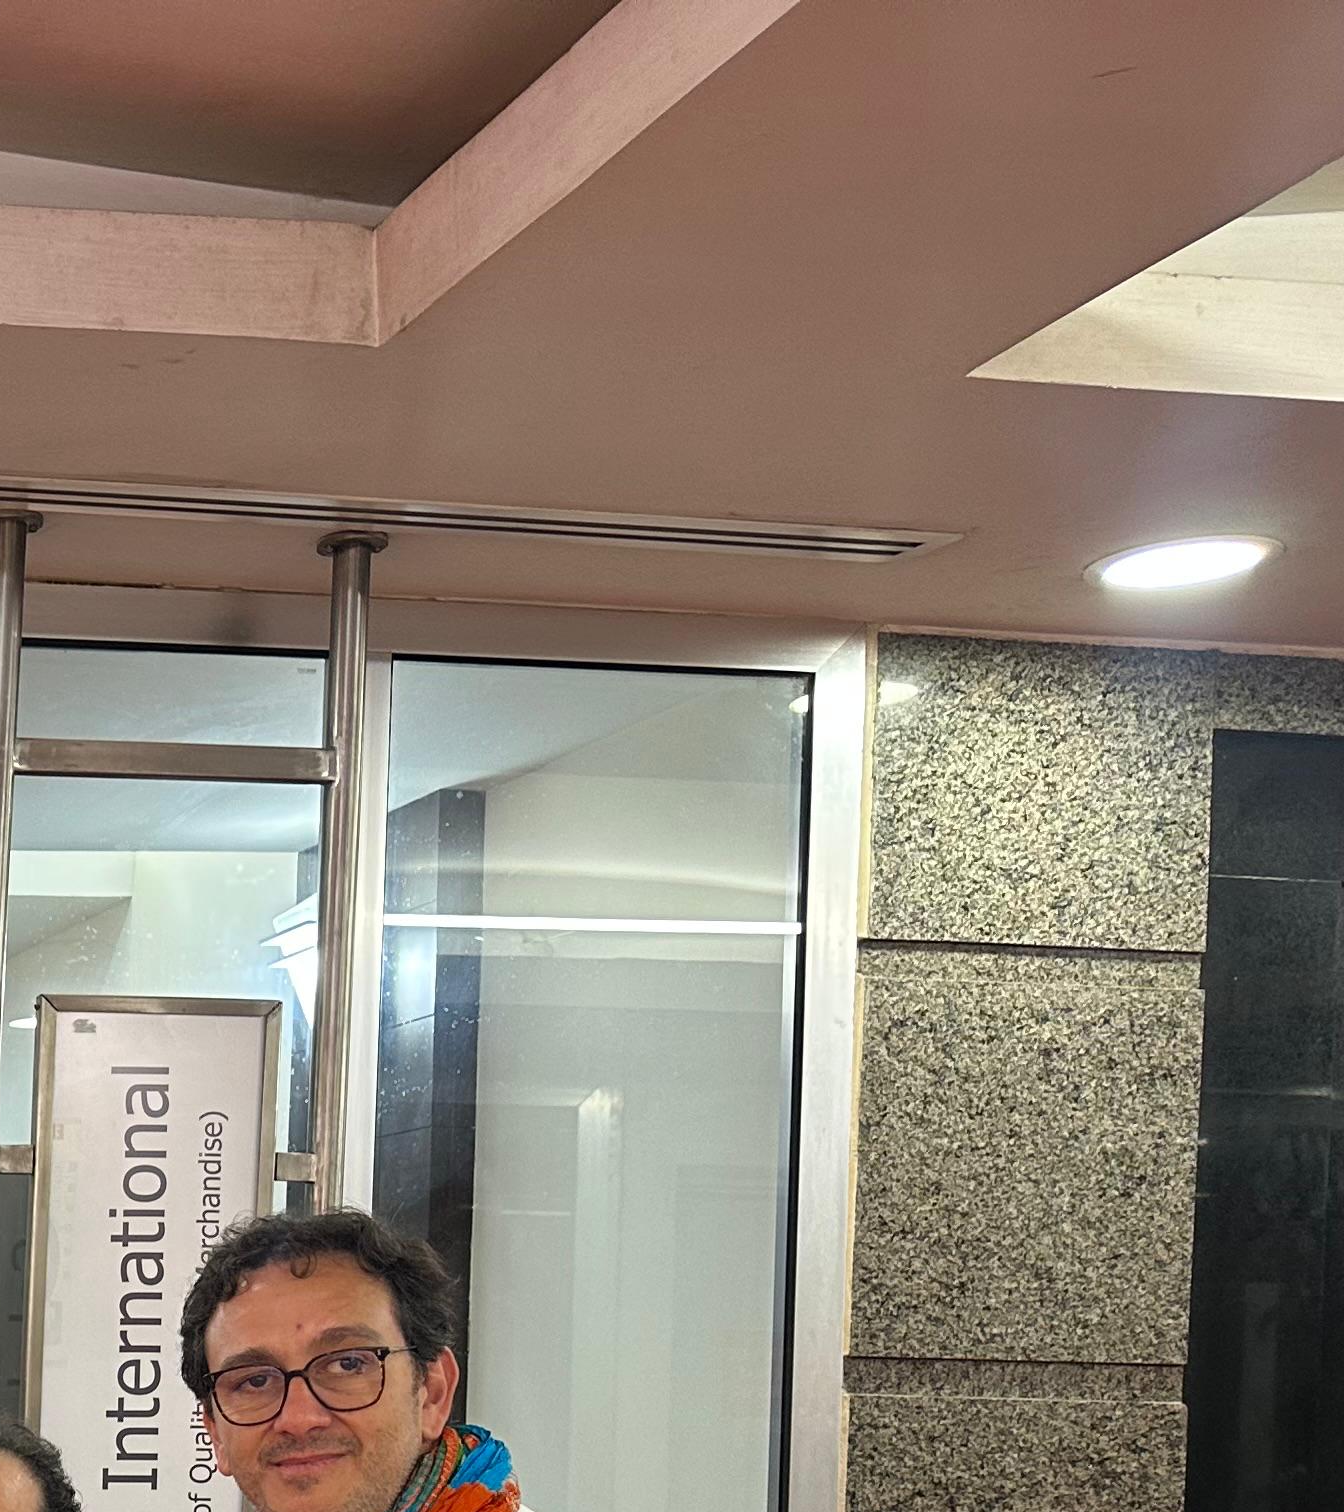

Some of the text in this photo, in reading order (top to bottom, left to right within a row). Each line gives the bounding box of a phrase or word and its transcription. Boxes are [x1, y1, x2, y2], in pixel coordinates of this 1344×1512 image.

[195, 1111, 229, 1274] erchandise)
[102, 1065, 171, 1492] International
[189, 1402, 218, 1484] Qualit
